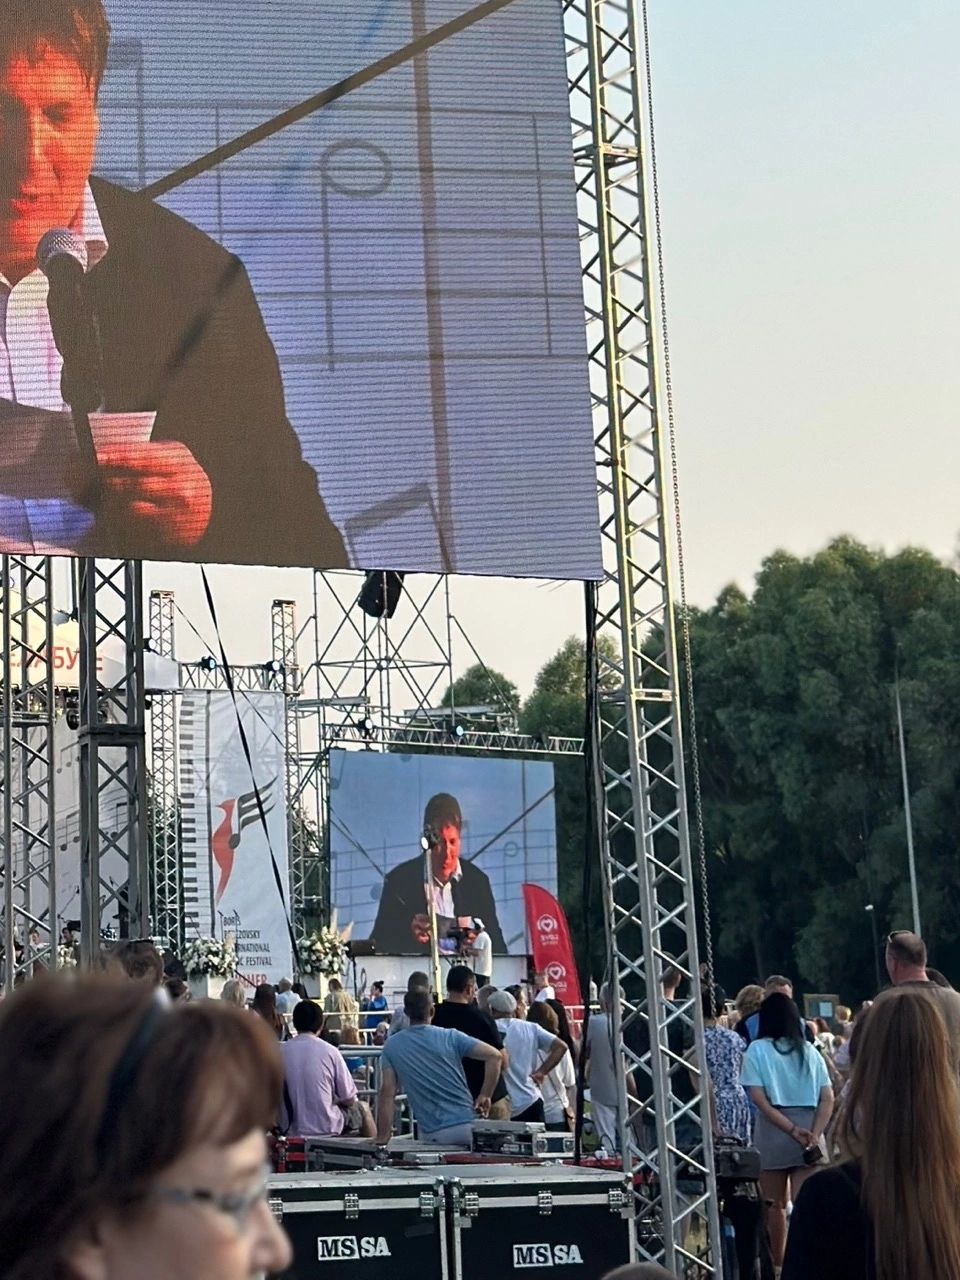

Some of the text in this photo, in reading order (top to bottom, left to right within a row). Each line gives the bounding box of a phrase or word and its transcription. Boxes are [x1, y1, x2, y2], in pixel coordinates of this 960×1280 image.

[245, 956, 272, 966] FESTIVAL
[319, 1237, 391, 1258] MS SA
[514, 1245, 583, 1265] MS SA
